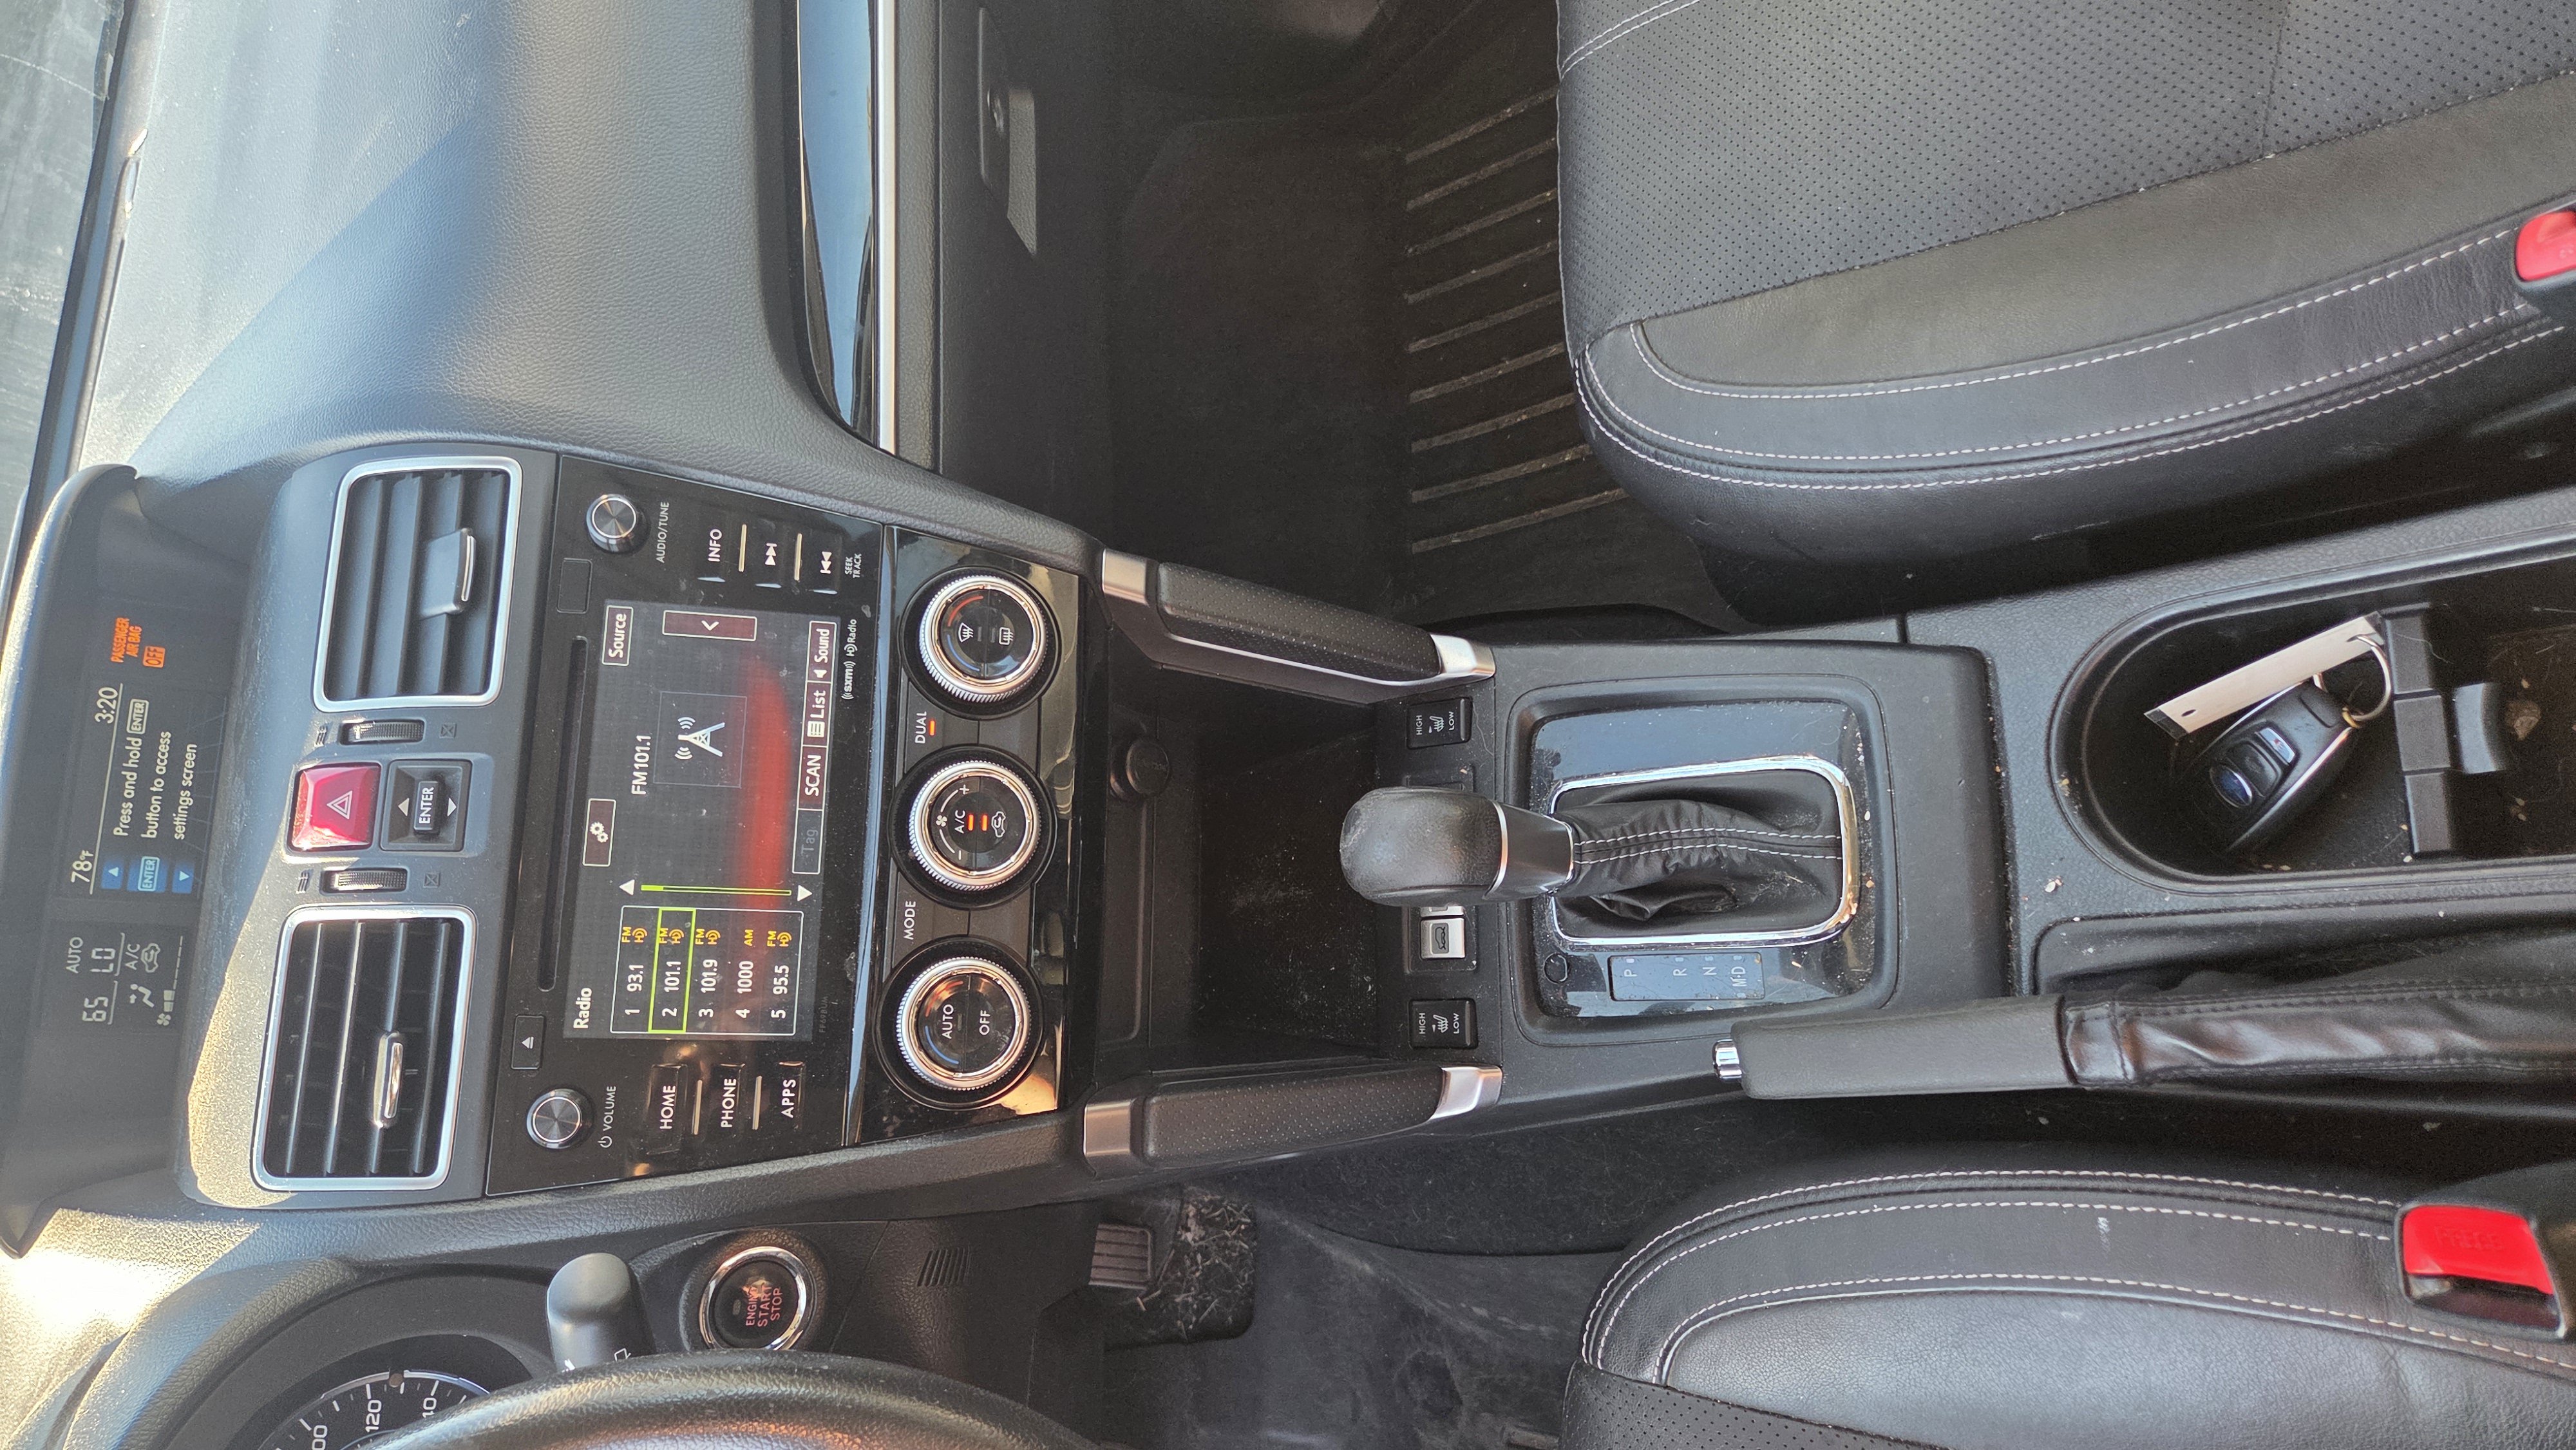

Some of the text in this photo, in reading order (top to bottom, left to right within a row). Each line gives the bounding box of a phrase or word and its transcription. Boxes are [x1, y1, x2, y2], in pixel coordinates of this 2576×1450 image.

[656, 502, 670, 563] AUDIO/TUNE
[708, 529, 722, 562] INFO
[845, 556, 853, 575] SEEK
[853, 554, 862, 578] TRACK
[110, 617, 131, 663] PASSENGER
[126, 626, 142, 657] AIR BAG
[609, 613, 626, 659] Source
[815, 628, 829, 663] Sound
[848, 619, 857, 643] Radio
[146, 647, 162, 665] OFF
[94, 686, 118, 724] 3:20
[811, 691, 826, 719] List
[914, 711, 927, 744] DUAL
[113, 702, 146, 836] Press and hold ENTER
[141, 731, 172, 838] button to access
[804, 755, 822, 796] SCAN
[172, 744, 198, 840] settings screen
[419, 786, 433, 824] ENTER
[954, 809, 966, 834] A/C
[800, 829, 817, 853] Tag
[143, 860, 156, 889] ENTER
[621, 927, 632, 943] FM
[659, 927, 668, 944] FM
[696, 928, 705, 945] FM
[904, 901, 916, 940] MODE
[66, 937, 84, 974] AUTO
[767, 931, 777, 946] FM
[125, 943, 140, 970] A/C
[1624, 969, 1637, 977] P
[1673, 968, 1687, 976] R
[1703, 966, 1716, 975] N
[628, 964, 644, 992] 93.1
[662, 961, 681, 1017] 2 101.1
[699, 959, 718, 1017] 3 101.9
[735, 930, 754, 1018] 4 1000 AM
[573, 988, 592, 1029] Radio
[771, 965, 790, 1019] 5 95.5
[82, 997, 109, 1022] 65
[941, 1004, 956, 1039] AUTO
[978, 1010, 992, 1035] OFF
[602, 1086, 616, 1131] VOLUME
[659, 1085, 676, 1129] HOME
[721, 1078, 737, 1128] PHONE
[781, 1079, 796, 1118] APPS
[757, 1285, 772, 1327] START
[771, 1287, 782, 1321] STOP
[365, 1400, 381, 1432] 120
